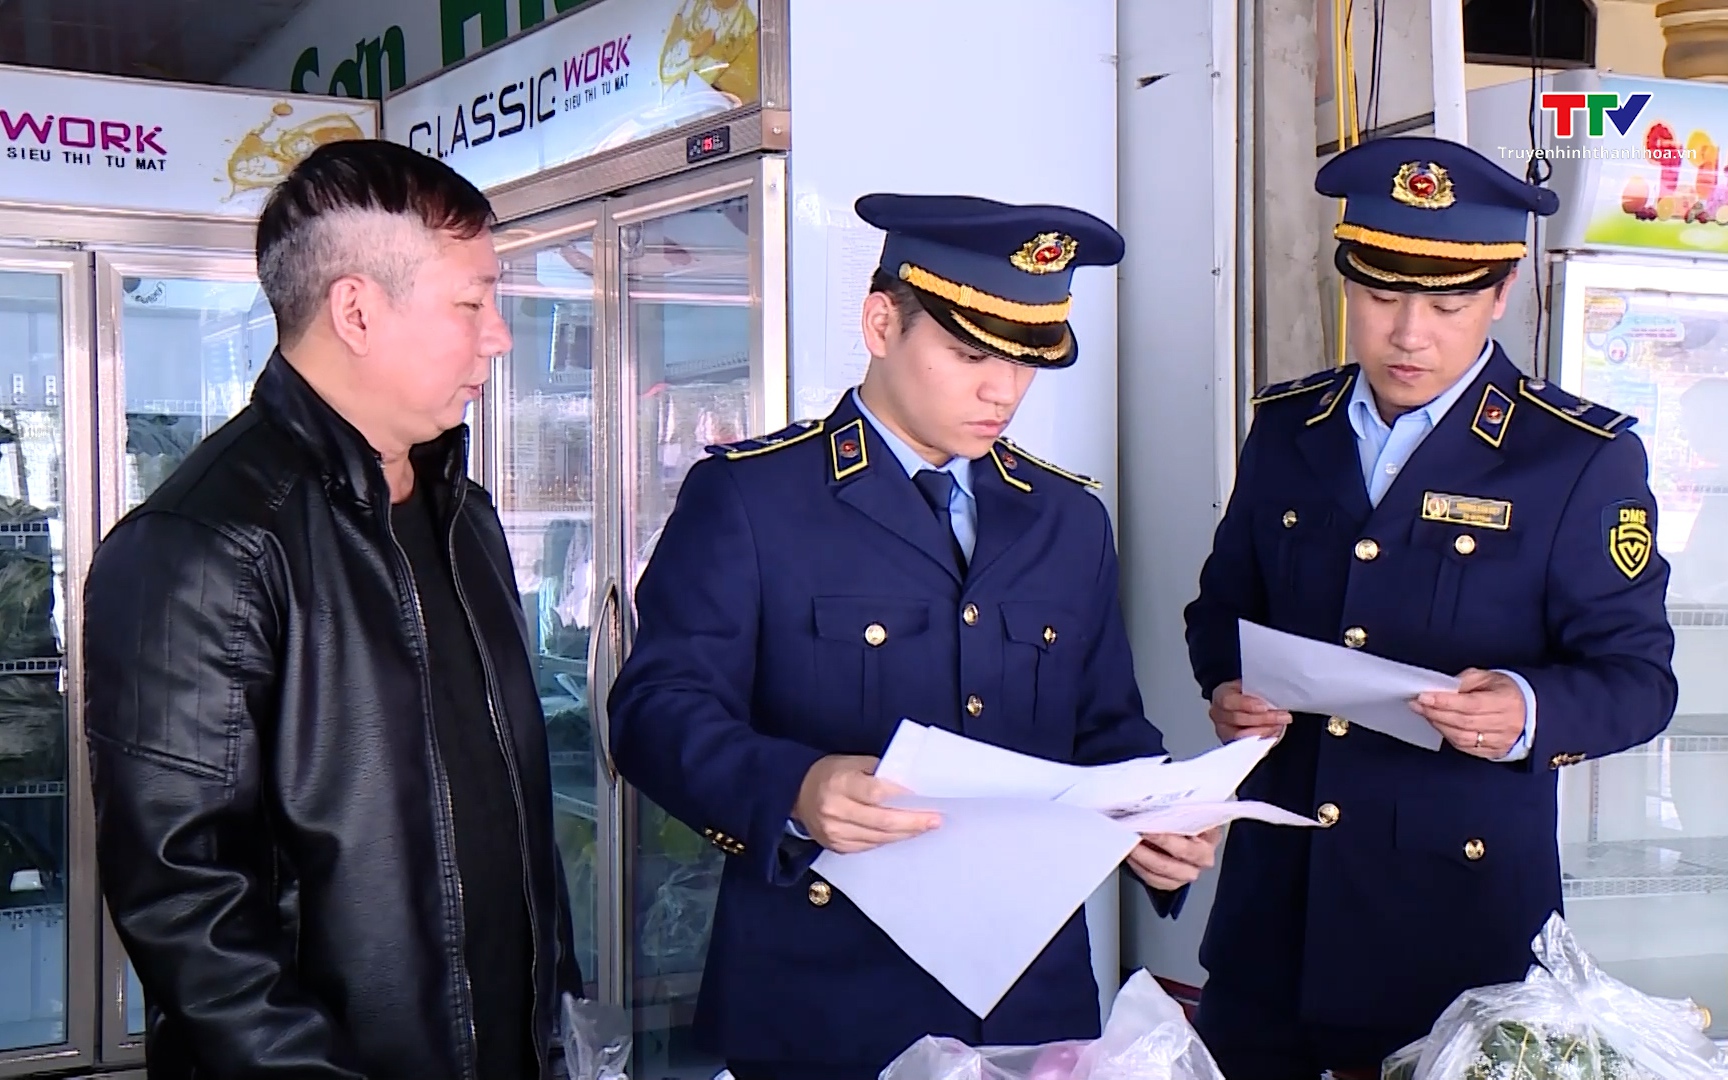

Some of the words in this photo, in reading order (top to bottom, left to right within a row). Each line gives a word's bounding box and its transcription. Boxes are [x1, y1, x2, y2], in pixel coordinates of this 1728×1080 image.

[409, 67, 557, 158] CLASSIC
[564, 33, 632, 92] WORK
[564, 93, 581, 112] SIEU
[584, 86, 597, 104] THI
[602, 80, 611, 96] TU
[614, 73, 629, 91] MAT
[0, 109, 168, 156] WORK
[7, 147, 51, 162] SIEU
[62, 151, 91, 166] THI
[105, 155, 125, 168] TU
[136, 158, 167, 171] MAT
[1619, 508, 1647, 525] DMS
